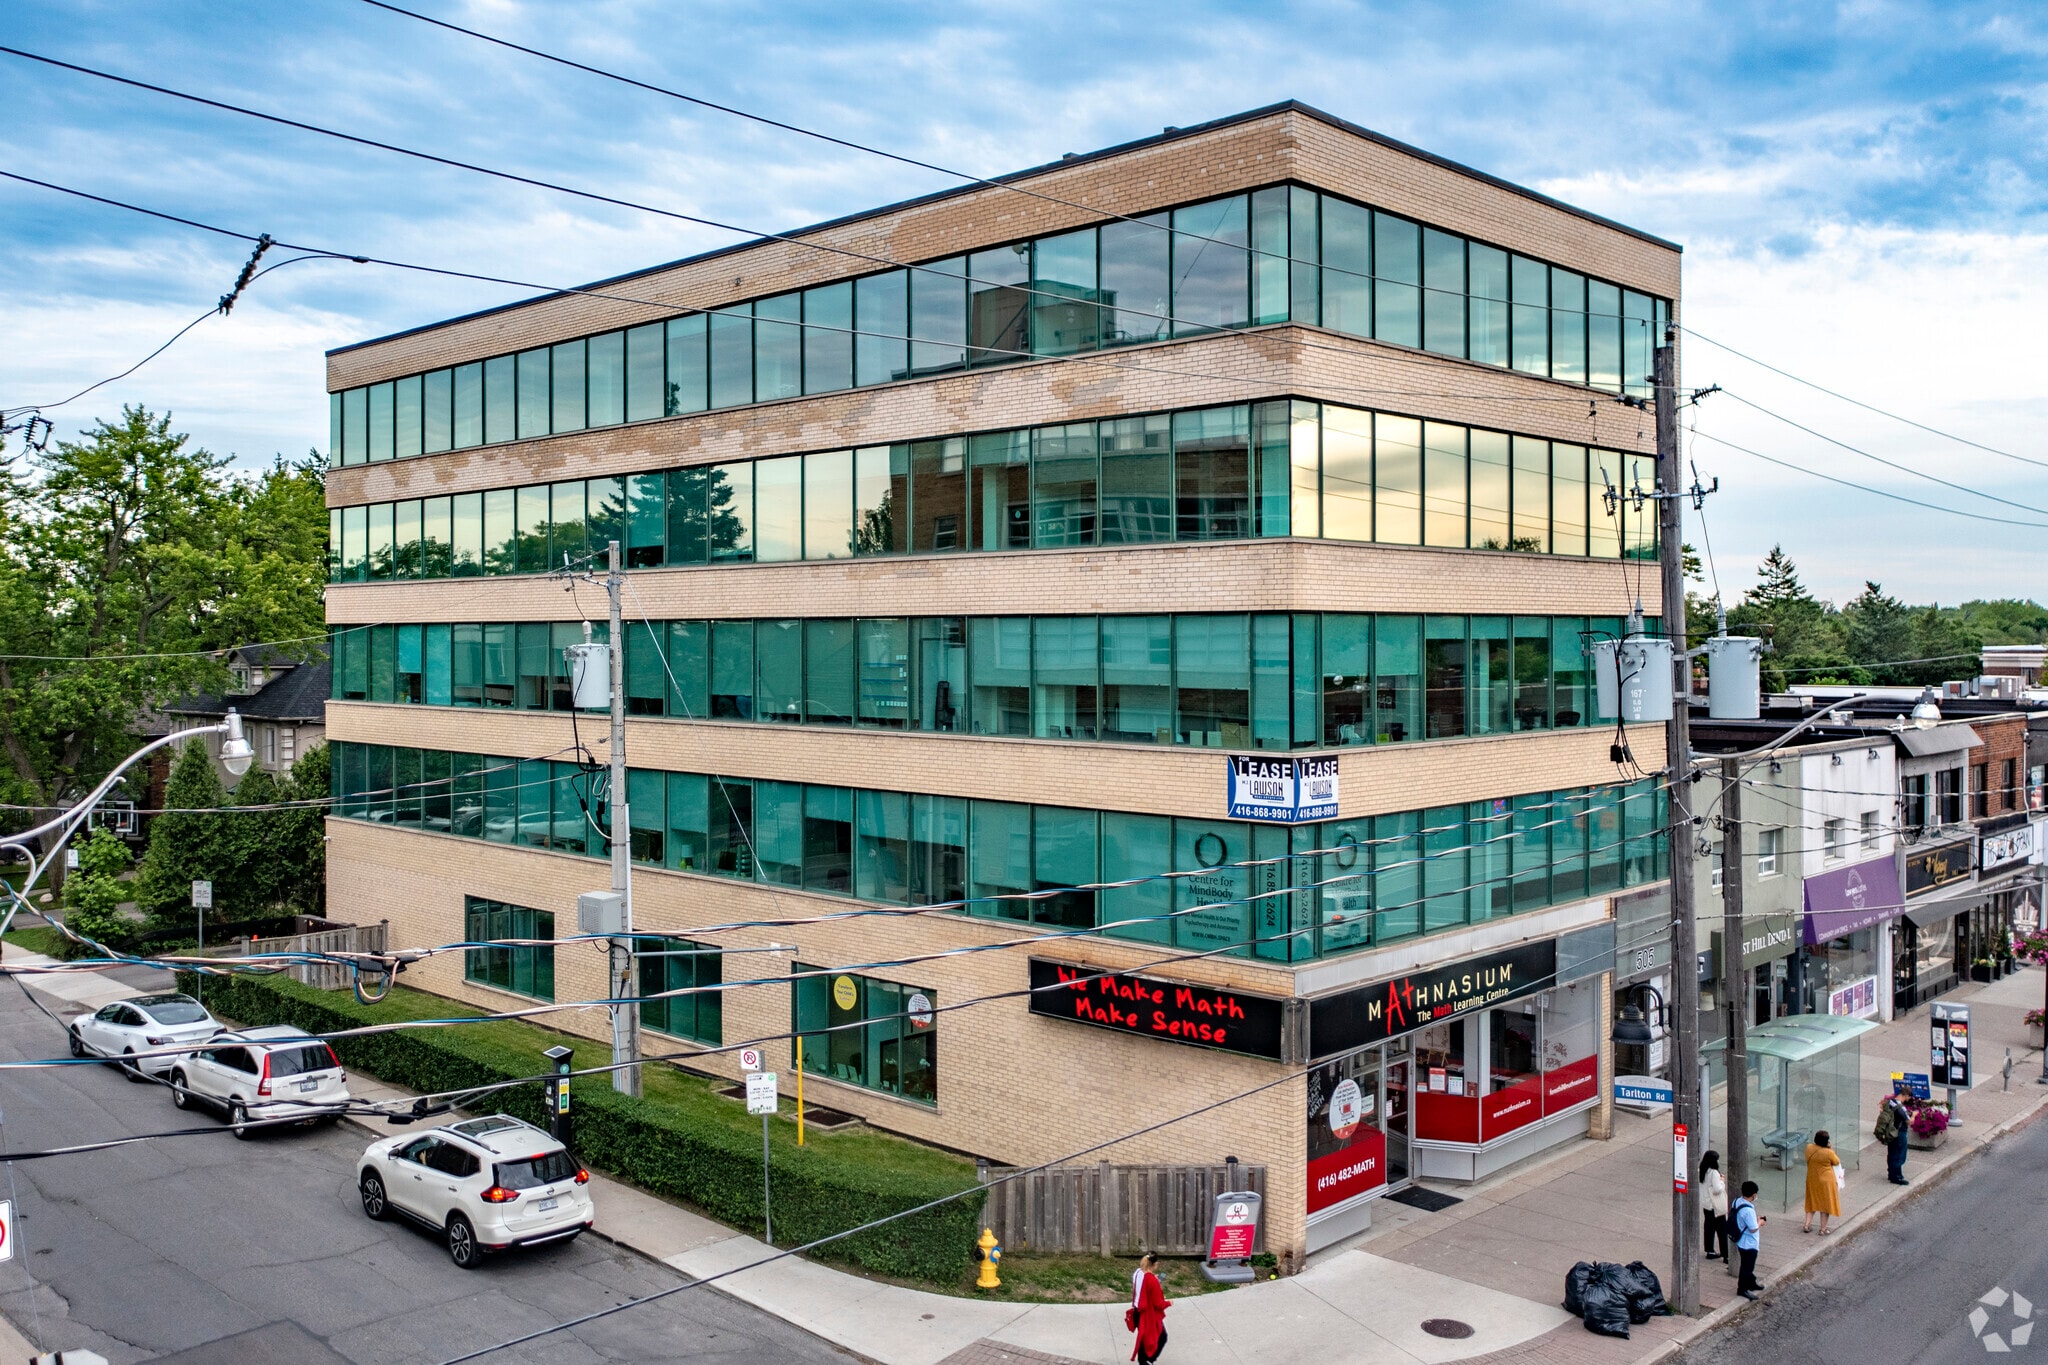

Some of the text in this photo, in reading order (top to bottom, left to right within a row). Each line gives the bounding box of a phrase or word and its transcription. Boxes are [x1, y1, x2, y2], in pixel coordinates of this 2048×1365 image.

[1239, 761, 1292, 779] LEASE
[1302, 761, 1337, 779] LEASE
[1249, 780, 1284, 796] LAWSON
[1309, 780, 1333, 797] LAWSON
[1236, 805, 1292, 819] 416-868-9901
[1300, 805, 1337, 818] 416-868-9901
[1189, 875, 1234, 887] Centre for
[1189, 885, 1234, 901] MindBody
[1636, 946, 1655, 972] 505
[1057, 965, 1245, 1020] We Make Math
[1417, 987, 1509, 1023] The Math Learning Centre
[1075, 997, 1227, 1044] Make Sense
[1621, 1087, 1665, 1101] Tarlton Rd
[1318, 1157, 1375, 1192] (416) 482-MATH
